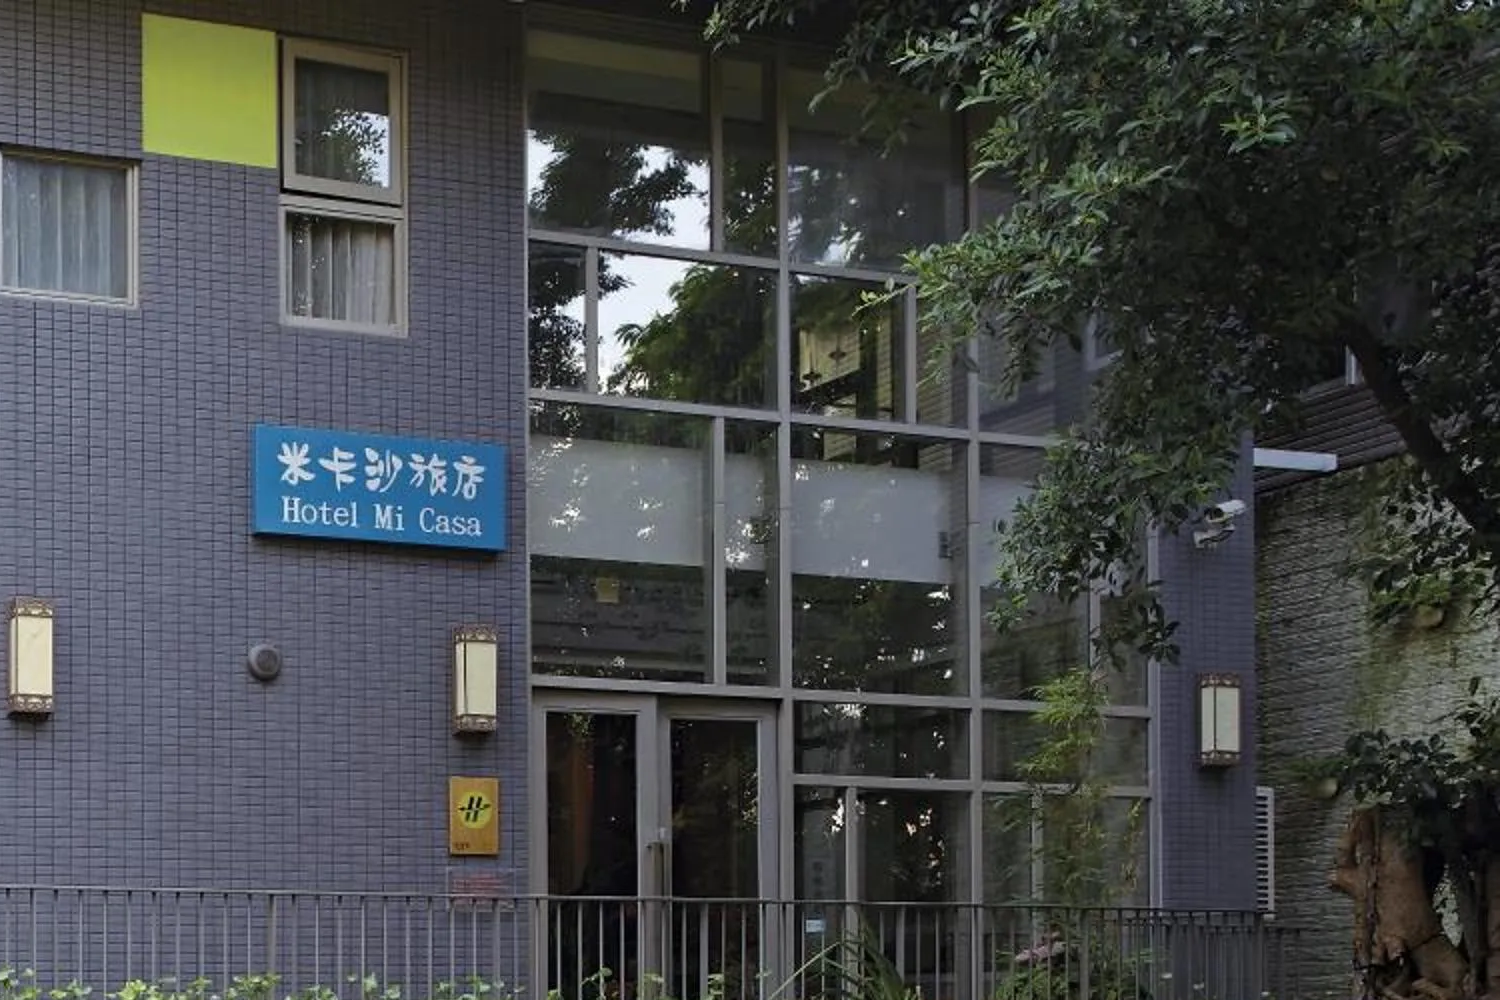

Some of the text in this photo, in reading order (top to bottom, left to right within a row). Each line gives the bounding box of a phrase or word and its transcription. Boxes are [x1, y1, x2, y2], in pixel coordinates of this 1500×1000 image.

[276, 441, 486, 500] 米卡沙旅店
[281, 496, 483, 536] Hotel Mi Casa
